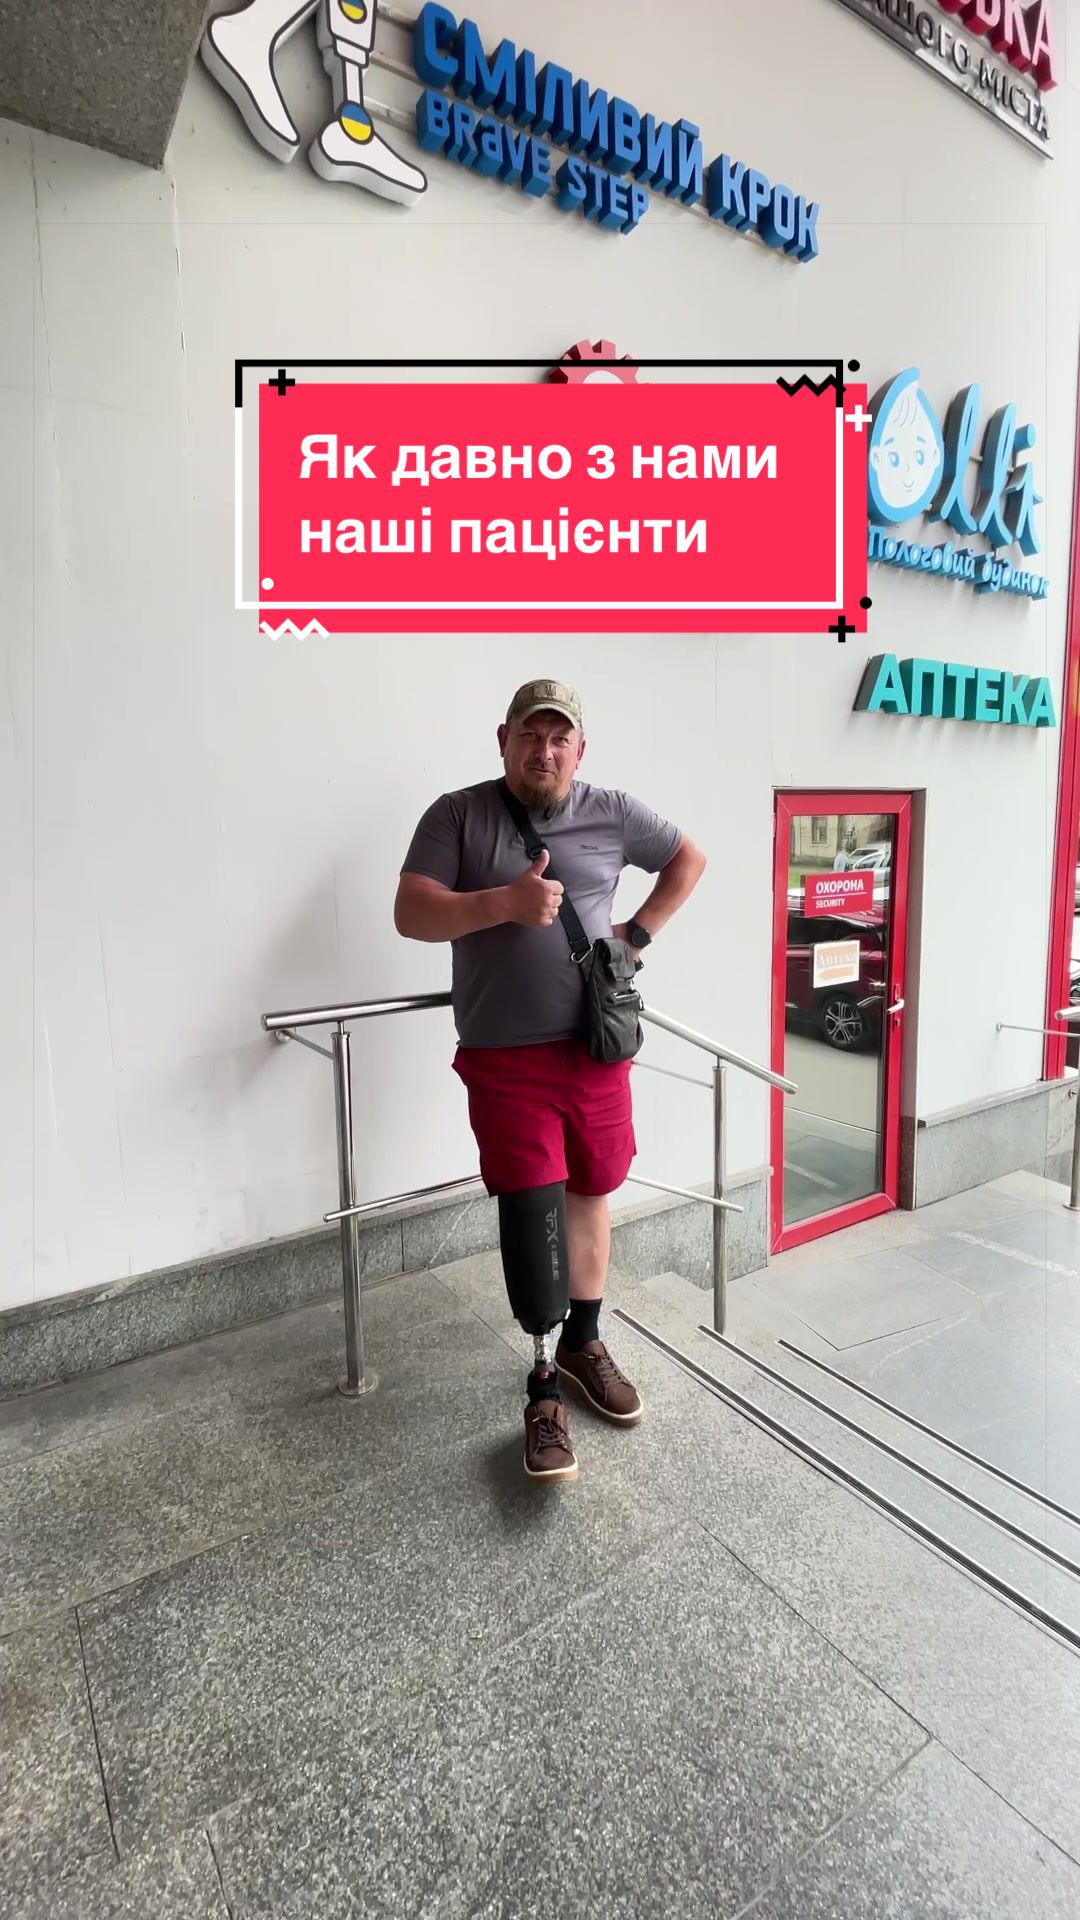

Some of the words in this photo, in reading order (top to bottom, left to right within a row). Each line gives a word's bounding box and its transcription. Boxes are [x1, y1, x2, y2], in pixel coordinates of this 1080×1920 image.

[414, 1, 704, 207] СМІЛИВИЙ
[708, 153, 820, 263] КРОК
[979, 57, 1051, 141] МІСТА
[556, 156, 650, 236] STEP
[868, 526, 976, 582] Пологовий
[979, 551, 1050, 599] будинок
[853, 653, 1057, 728] АПТЕКА
[815, 879, 864, 895] ОХОРОНА
[815, 898, 845, 908] SECURITY
